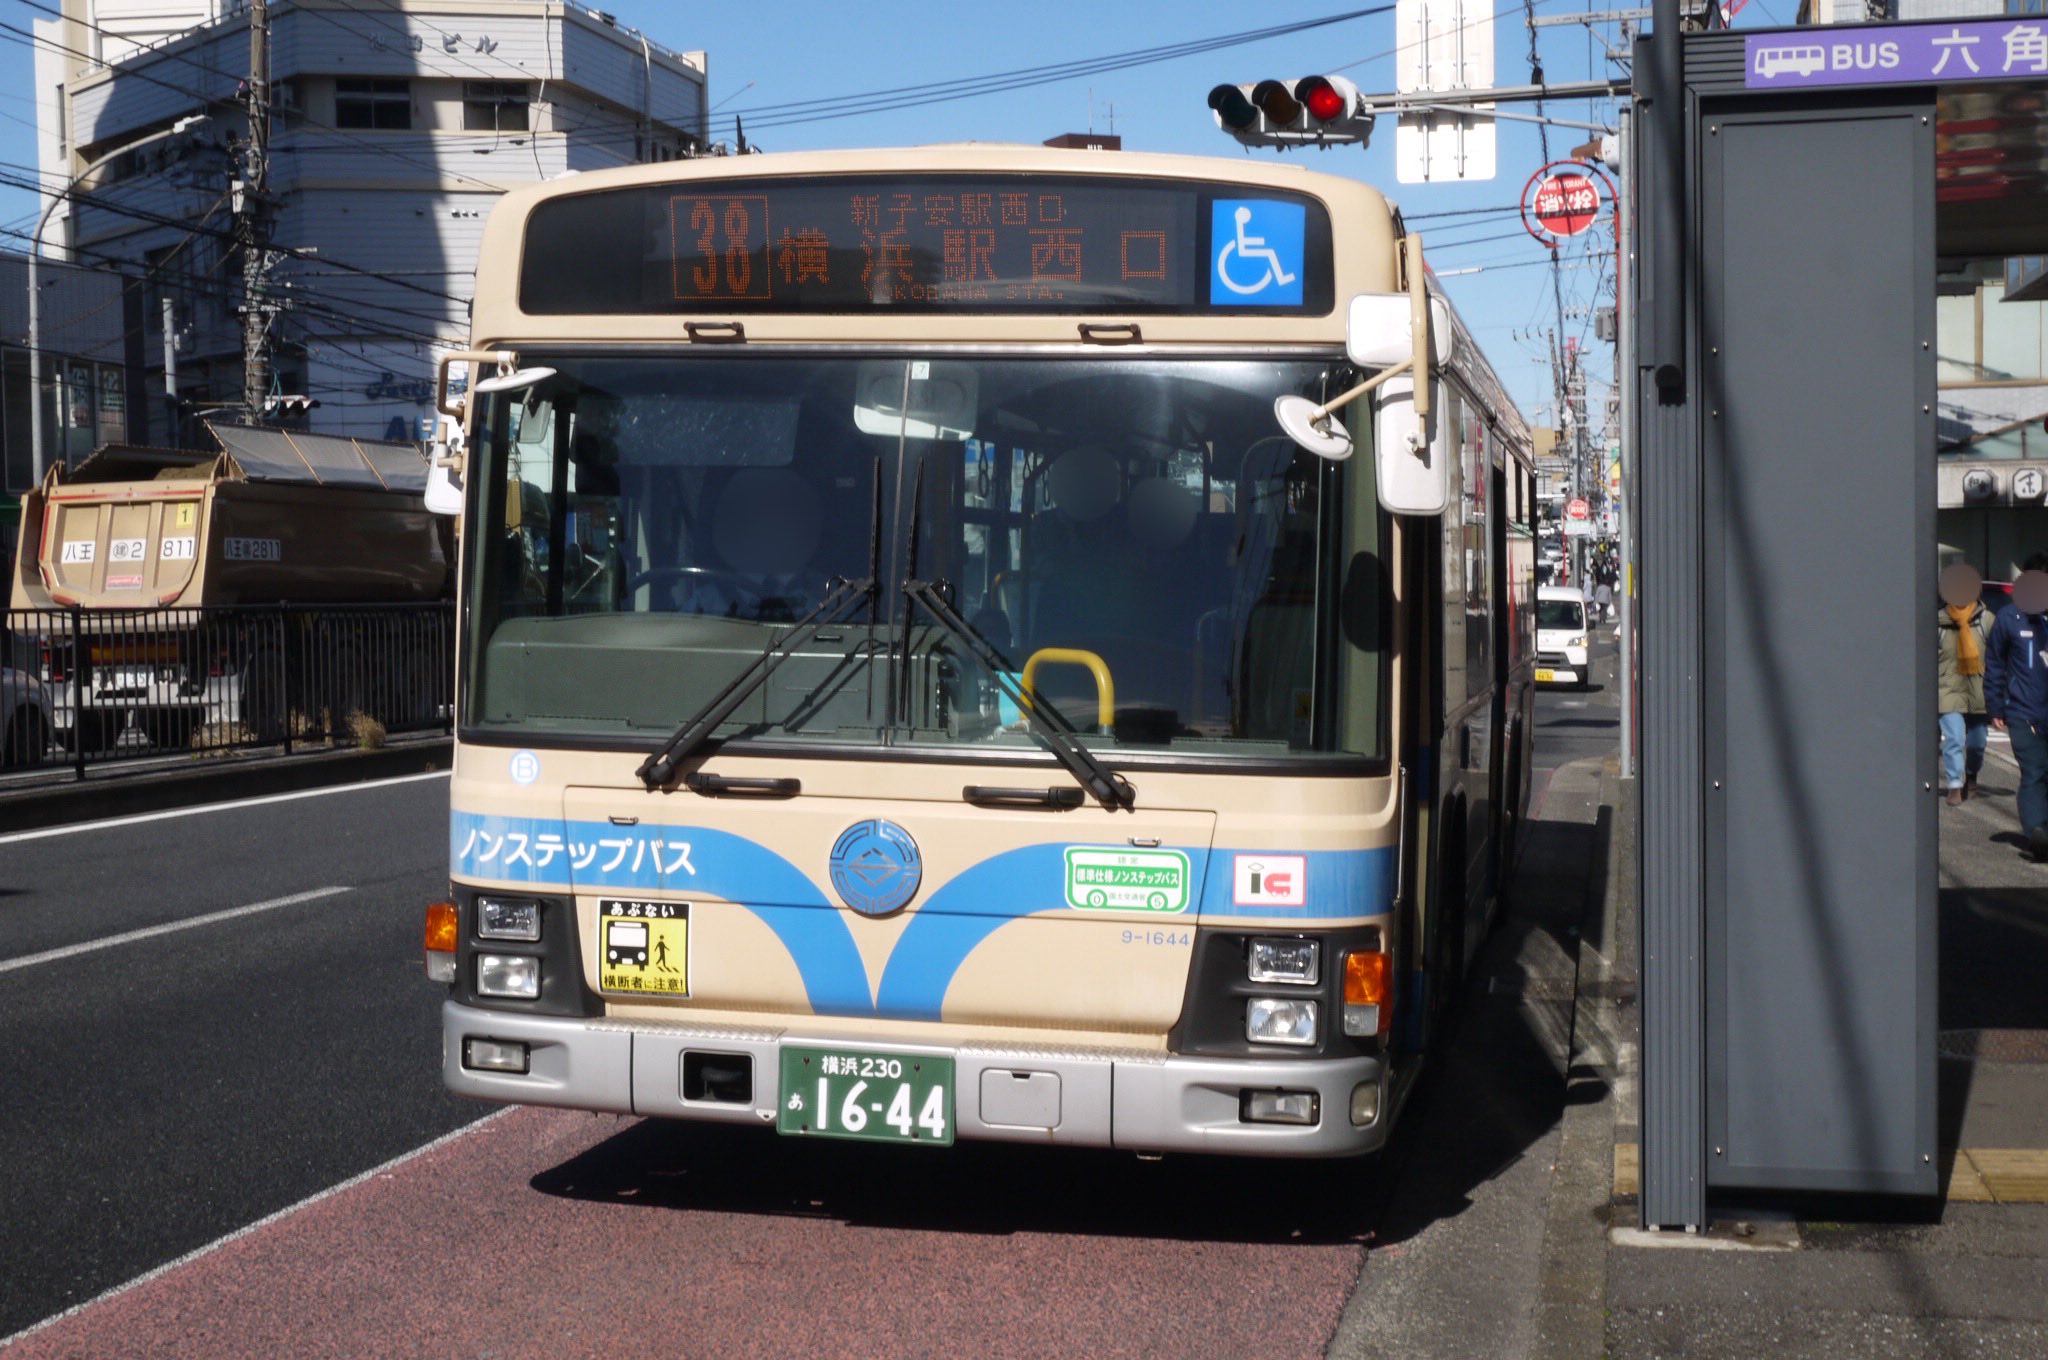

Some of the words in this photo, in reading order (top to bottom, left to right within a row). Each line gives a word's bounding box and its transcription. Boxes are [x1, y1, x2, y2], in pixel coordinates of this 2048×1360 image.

[1832, 42, 1900, 71] BUS
[851, 193, 1062, 226] 新子安駅西口
[1540, 189, 1593, 217] 消火栓
[691, 200, 750, 294] 38
[777, 226, 1167, 284] 横浜駅西口
[182, 508, 188, 523] 1
[64, 543, 93, 561] 八王
[163, 539, 193, 558] 811
[517, 757, 533, 779] B
[460, 829, 696, 876] ノンステップバス
[1076, 868, 1179, 885] 標準仕様ノンステップバス
[610, 902, 675, 918] あぶない
[1121, 930, 1190, 947] 9-1644
[604, 974, 684, 991] 横断者に注意!
[787, 1092, 804, 1111] あ
[816, 1077, 945, 1138] 16-44
